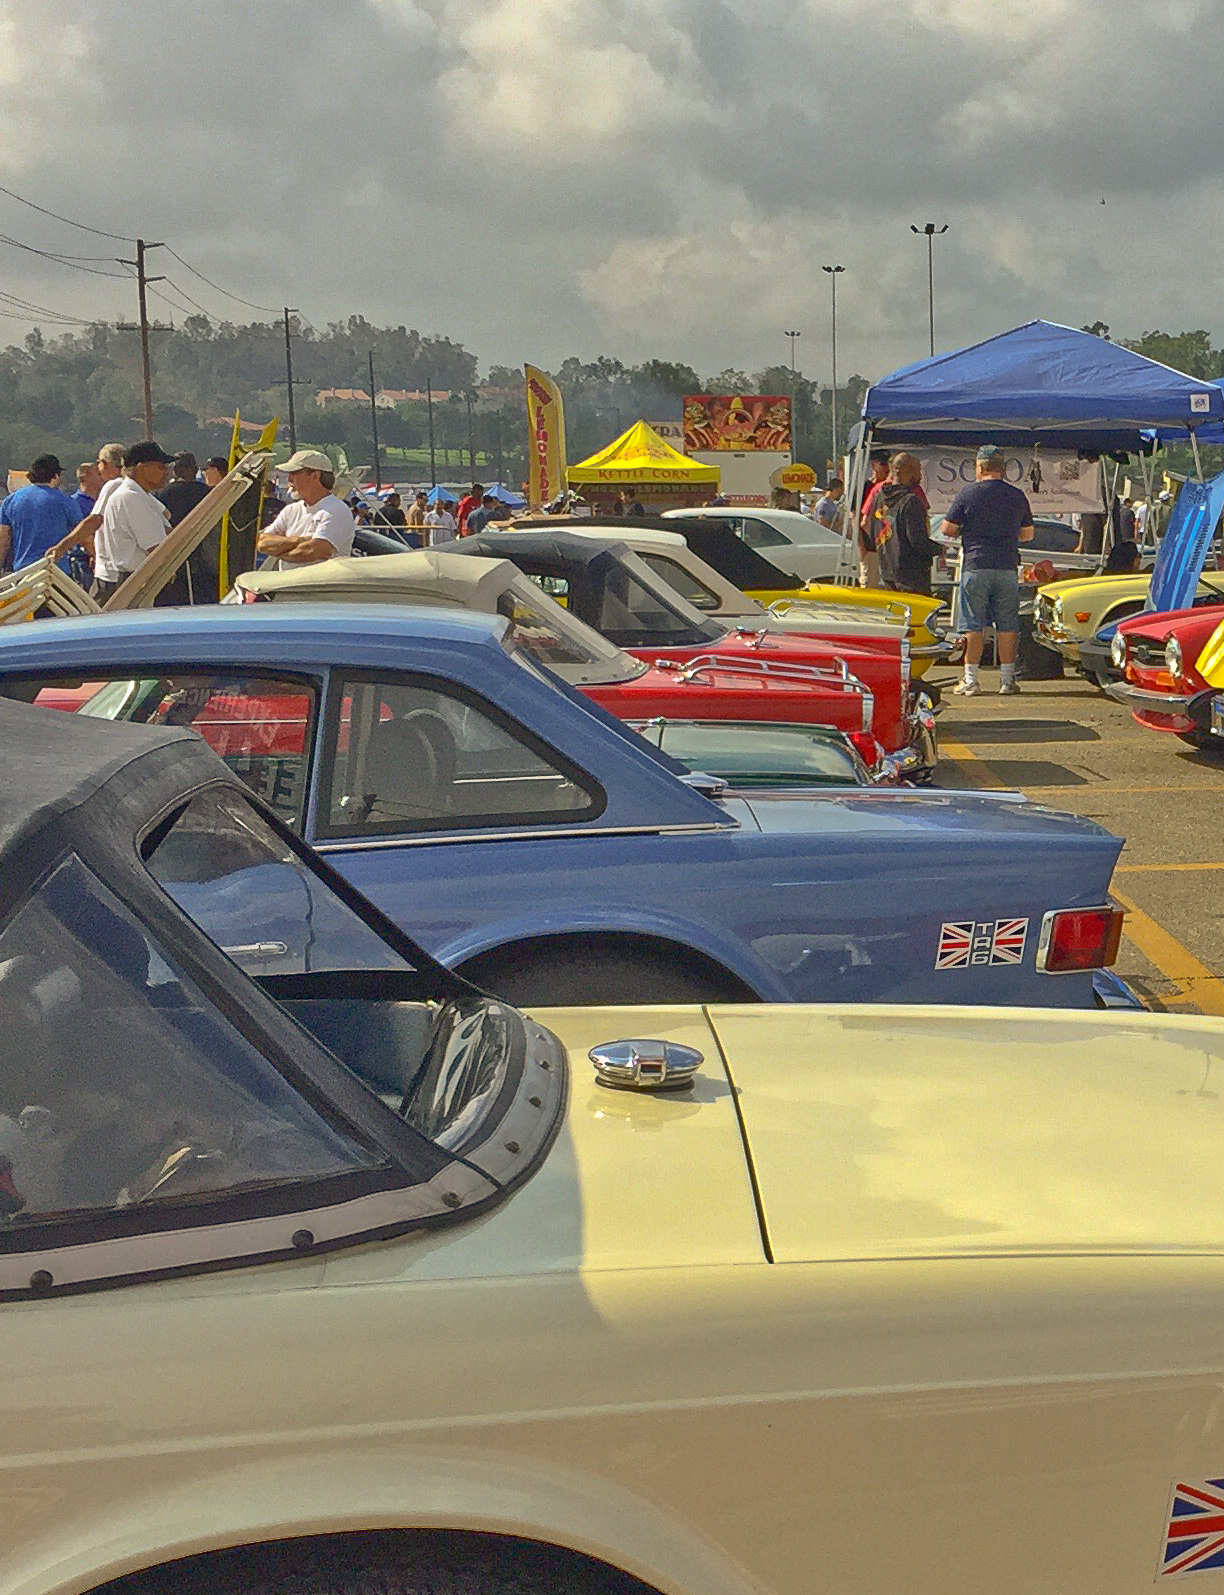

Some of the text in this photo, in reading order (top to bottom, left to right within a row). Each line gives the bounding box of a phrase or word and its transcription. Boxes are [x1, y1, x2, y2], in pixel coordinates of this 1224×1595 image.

[535, 406, 550, 502] LEMONADE
[936, 457, 1045, 483] SCOA
[598, 469, 690, 480] KETTLE CORN
[970, 922, 994, 965] TR6
